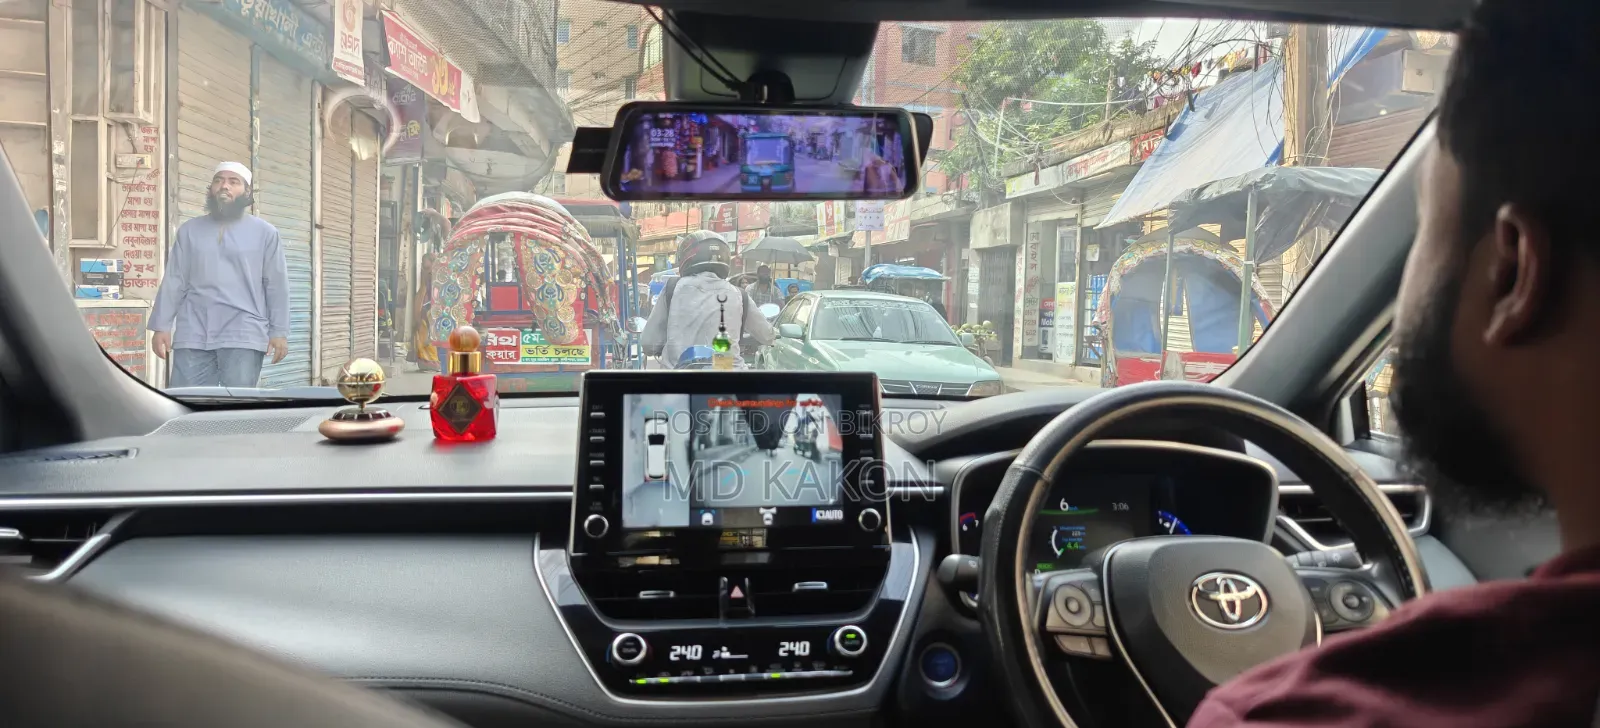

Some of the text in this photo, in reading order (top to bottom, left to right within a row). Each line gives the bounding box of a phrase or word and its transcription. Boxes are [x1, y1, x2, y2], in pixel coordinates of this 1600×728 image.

[525, 344, 586, 356] ভর্তি চলছে
[1059, 497, 1069, 512] 6
[824, 509, 843, 520] AUTO
